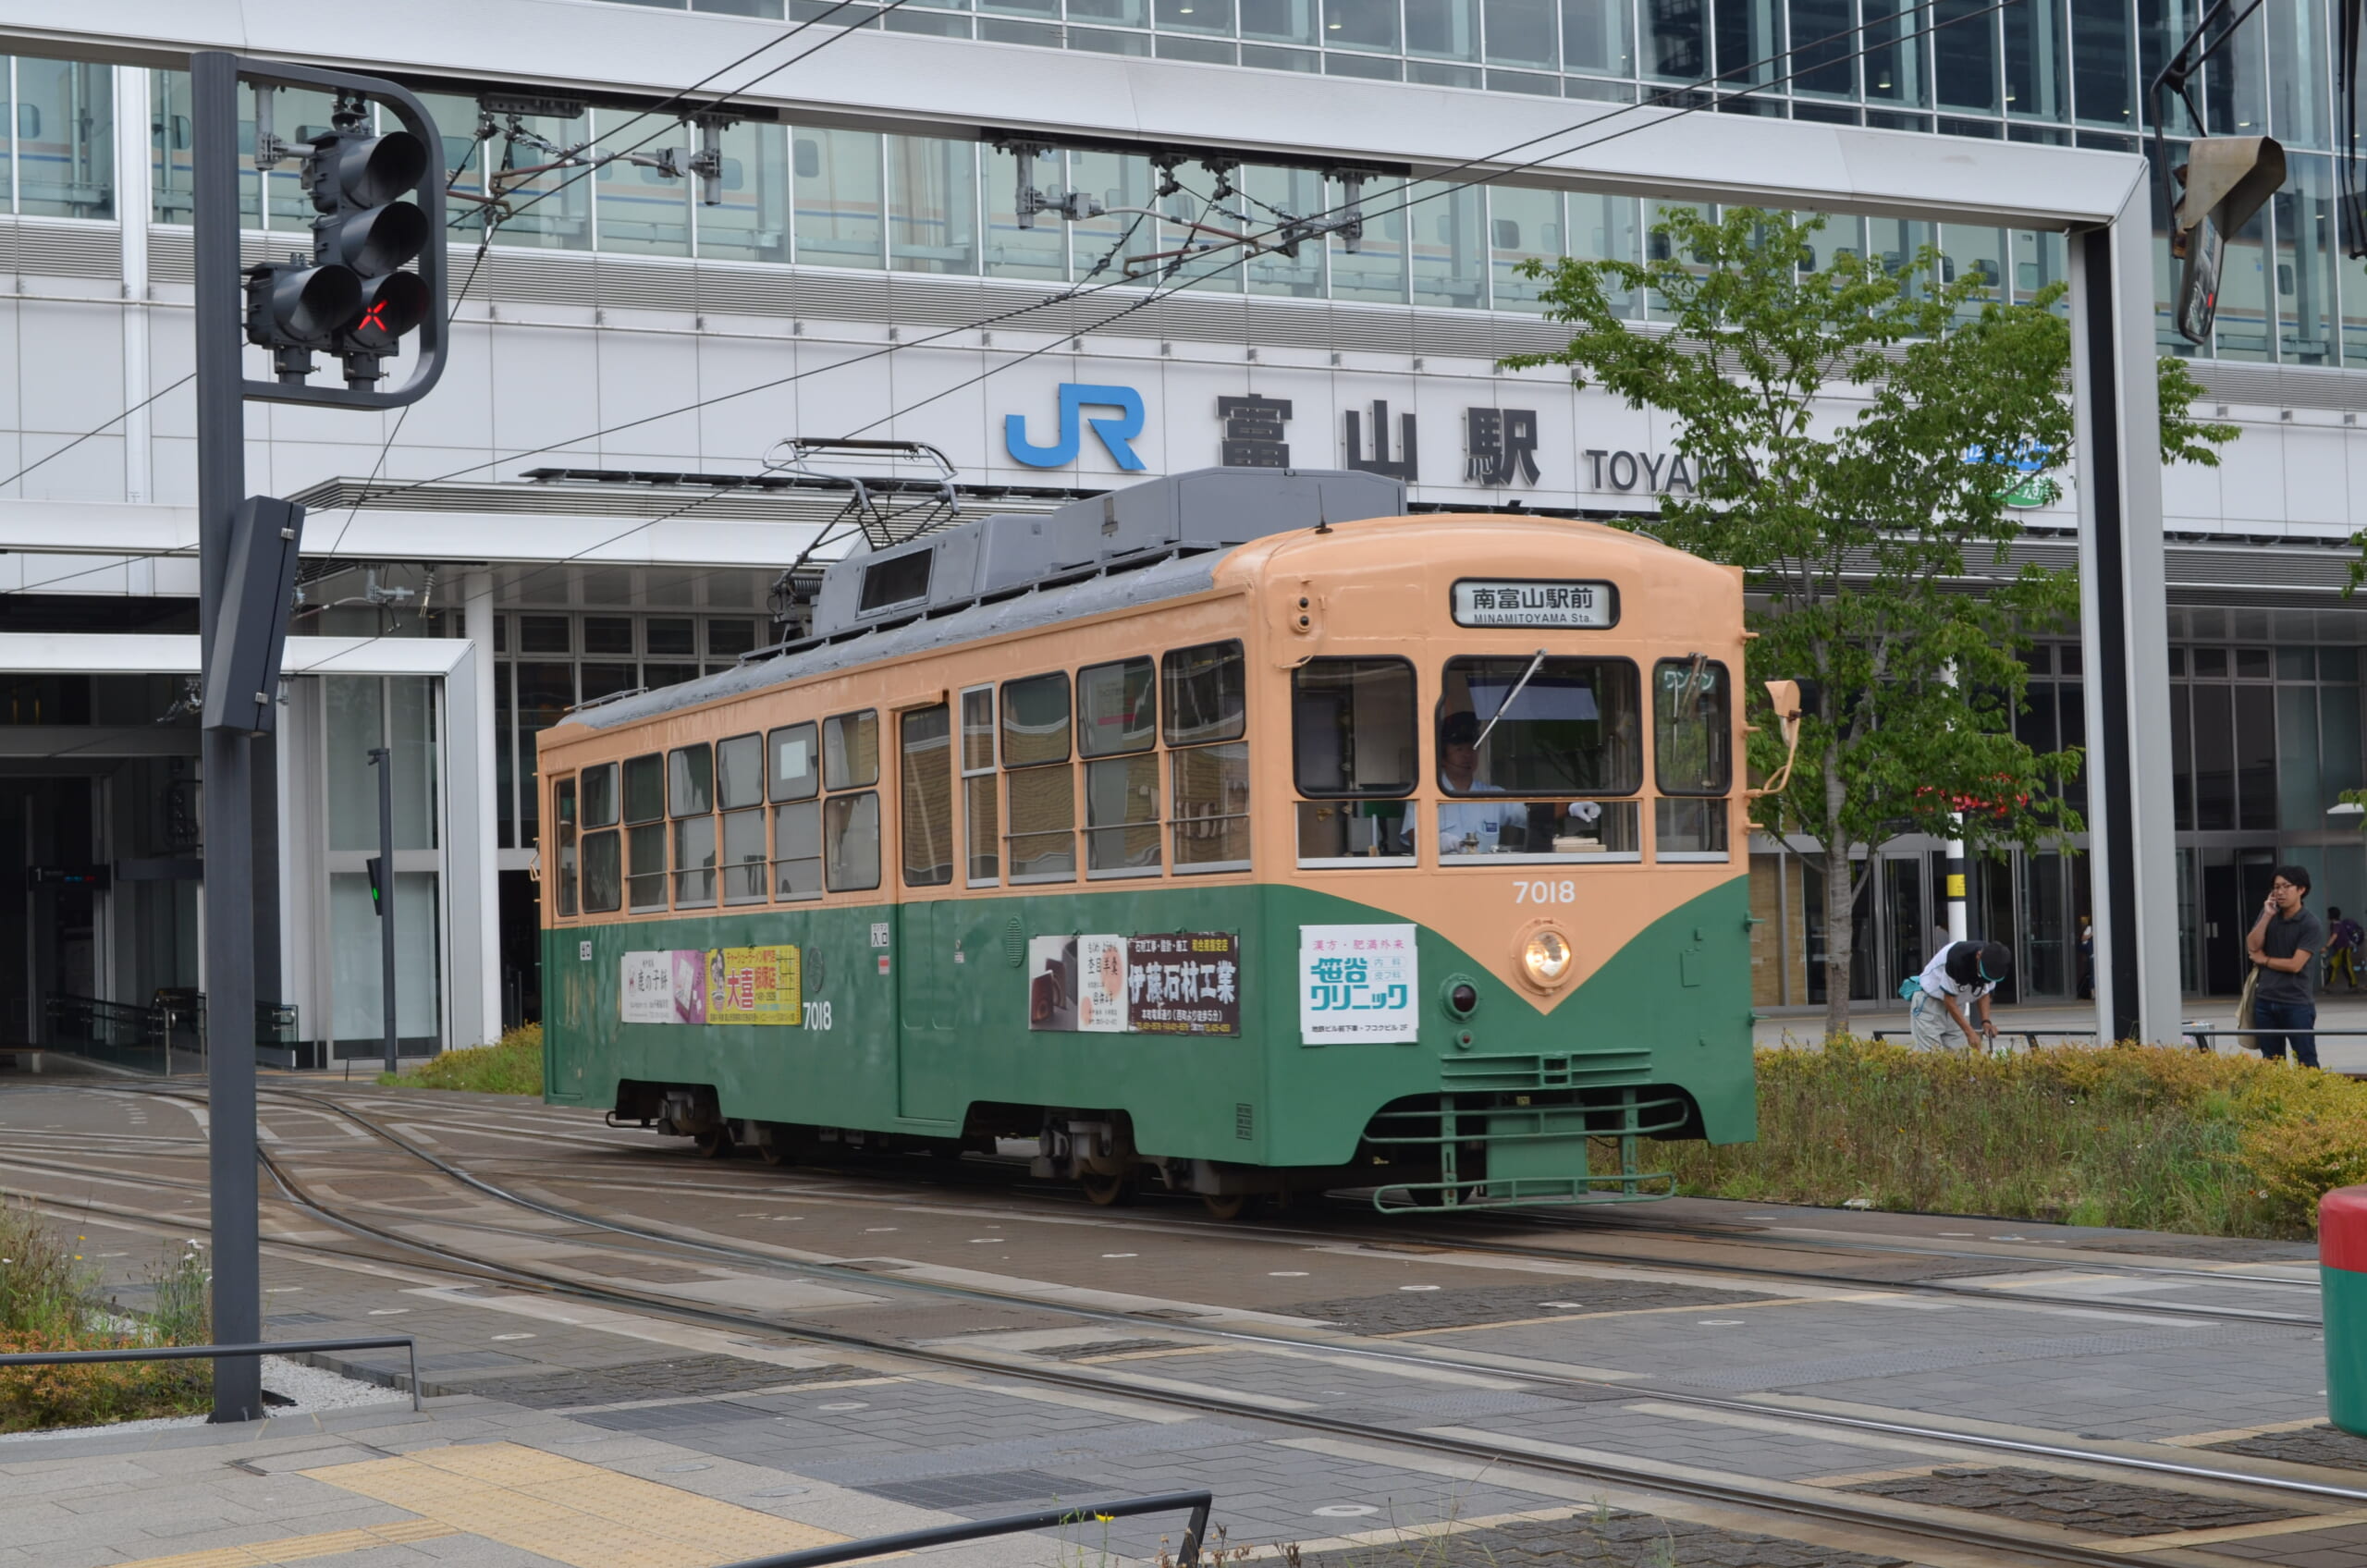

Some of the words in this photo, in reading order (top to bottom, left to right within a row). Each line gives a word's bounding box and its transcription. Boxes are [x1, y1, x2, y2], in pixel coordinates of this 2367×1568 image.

[1005, 382, 1147, 471] JR
[1216, 393, 1540, 486] 富山駅
[1472, 587, 1594, 610] 南富山駅前
[1474, 613, 1567, 624] MINAMITOYAMA
[1571, 613, 1594, 623] Sta.
[1663, 670, 1715, 691] ワンン
[1513, 880, 1576, 904] 7018
[872, 932, 888, 946] 入口
[1312, 938, 1404, 951] 漢方・肥満外来
[1128, 960, 1236, 1005] 伊藤石材工業
[1310, 957, 1367, 984] 笹谷
[726, 967, 754, 1011] 大喜
[1310, 984, 1408, 1011] クリニック
[803, 1001, 832, 1031] 7018
